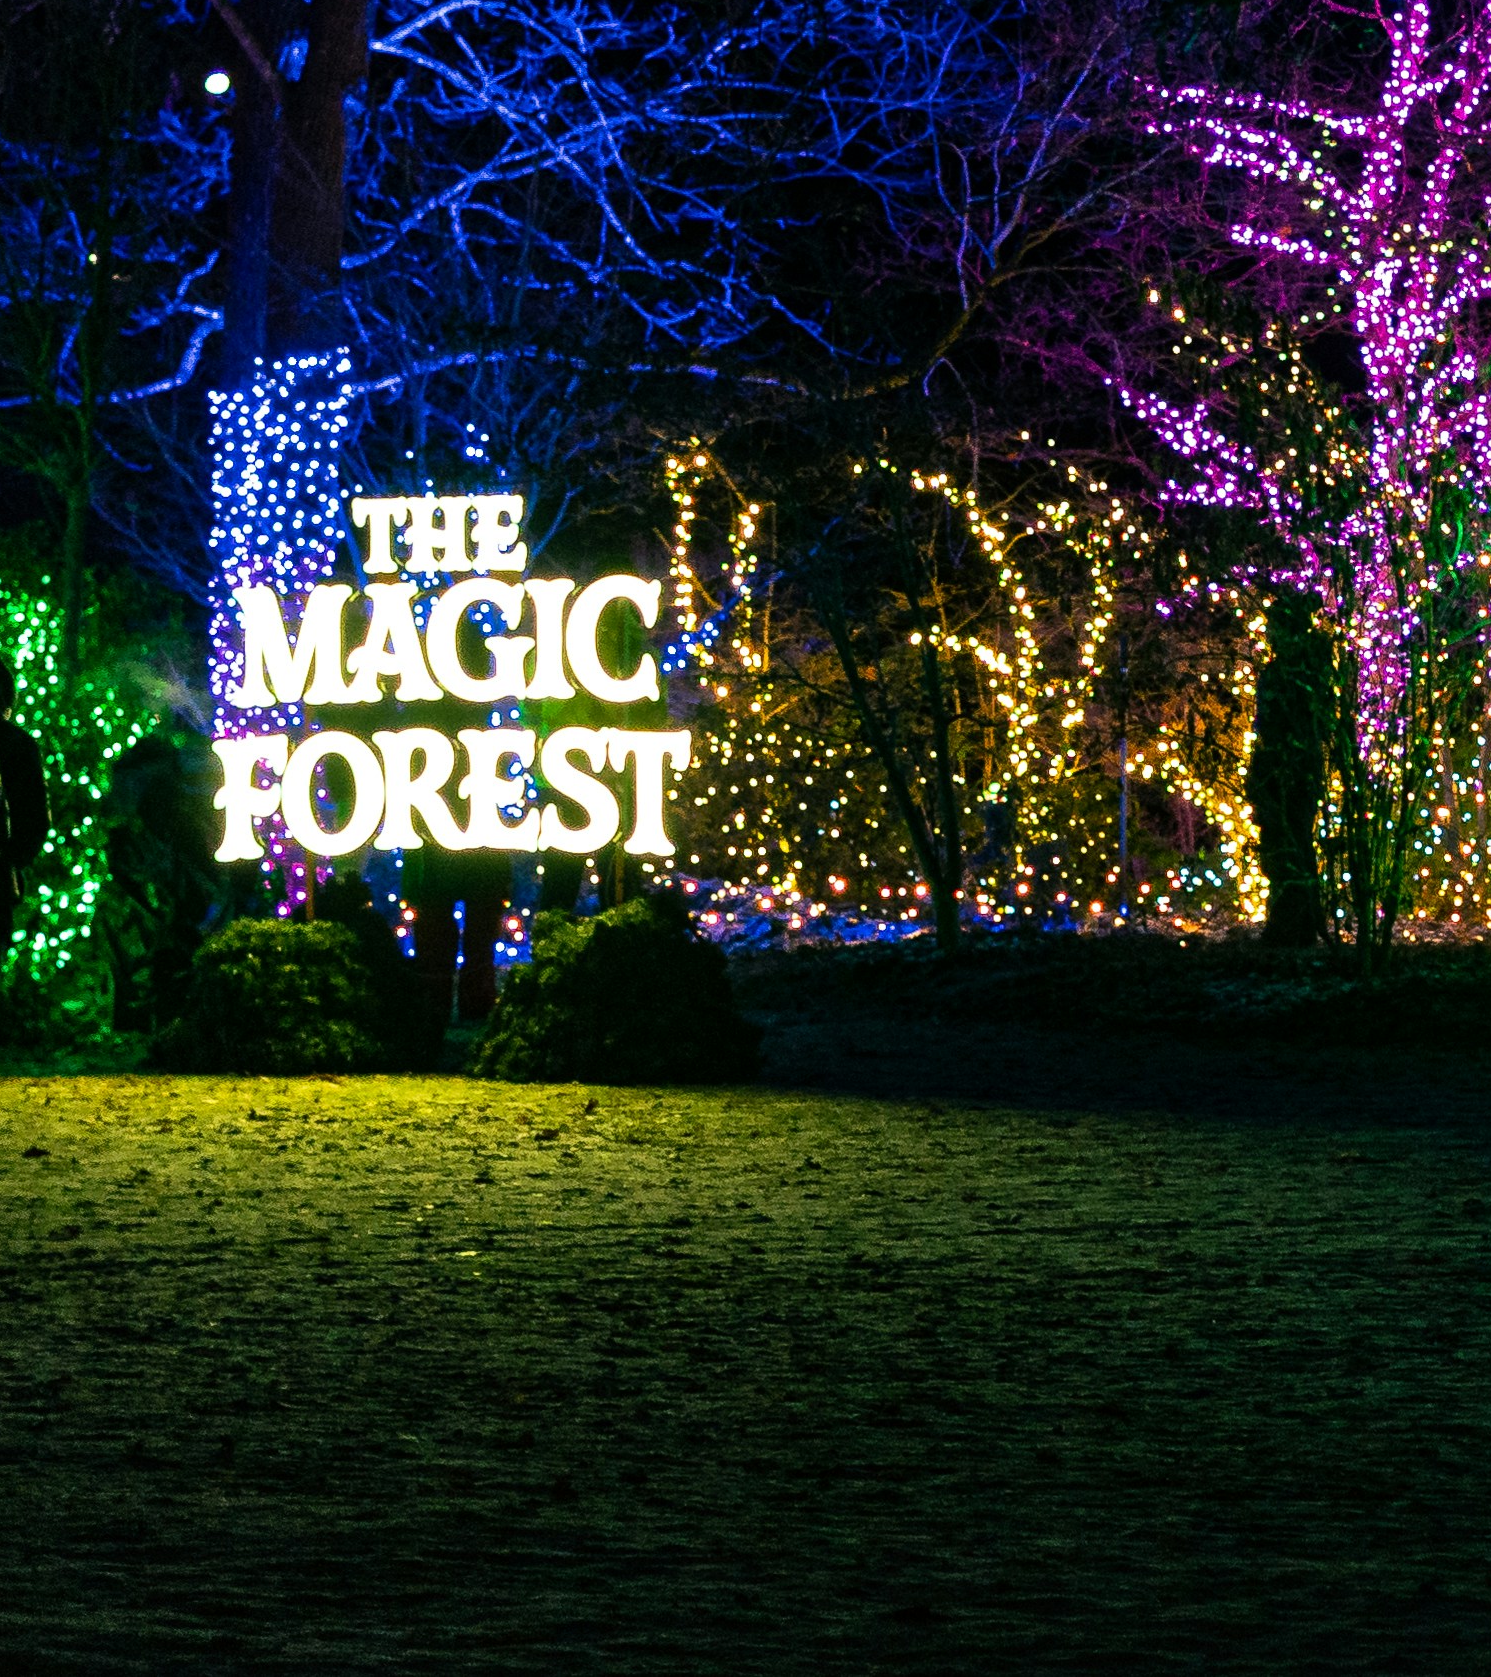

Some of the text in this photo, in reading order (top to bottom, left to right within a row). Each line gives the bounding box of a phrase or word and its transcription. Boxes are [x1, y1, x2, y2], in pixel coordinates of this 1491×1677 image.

[352, 494, 527, 574] THE
[232, 574, 662, 708] MAGIC
[212, 727, 692, 863] FOREST
